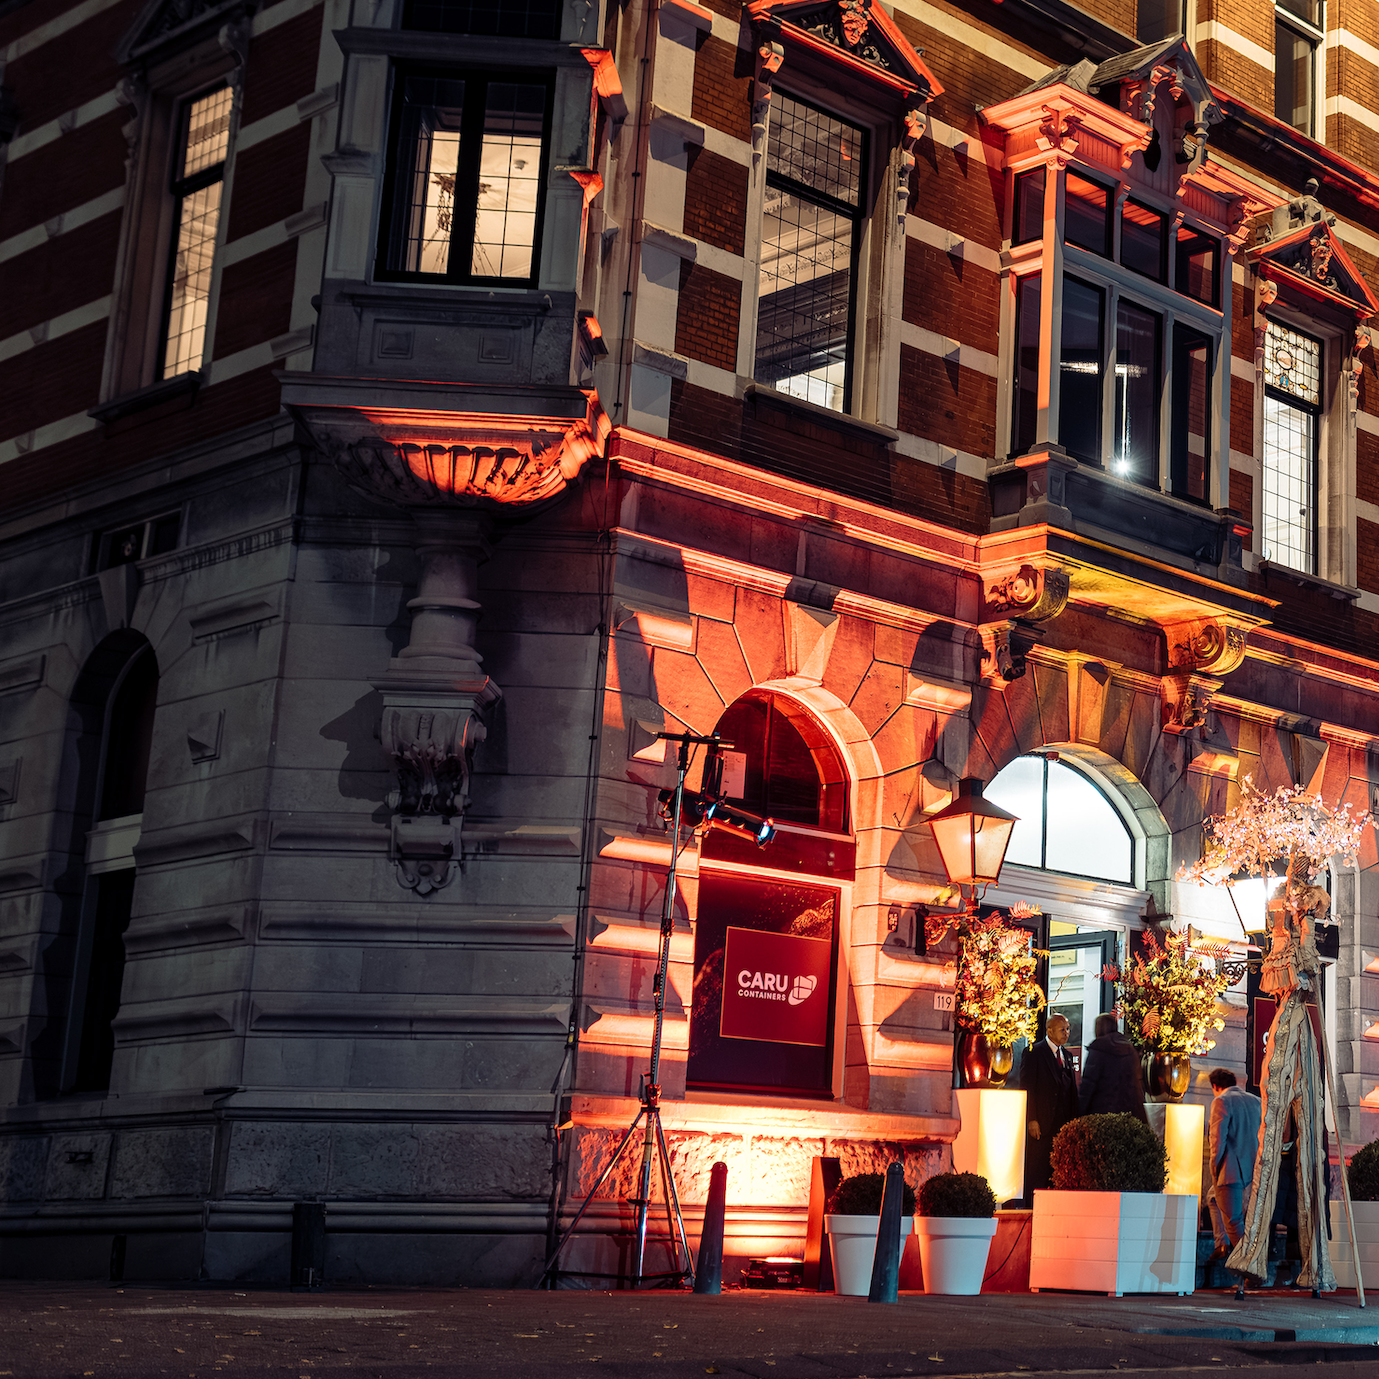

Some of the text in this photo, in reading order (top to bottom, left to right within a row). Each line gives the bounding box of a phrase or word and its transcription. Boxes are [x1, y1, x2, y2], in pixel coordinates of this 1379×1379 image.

[738, 970, 788, 992] CARU
[738, 989, 786, 1002] CONTAINERS
[937, 995, 952, 1009] 119
